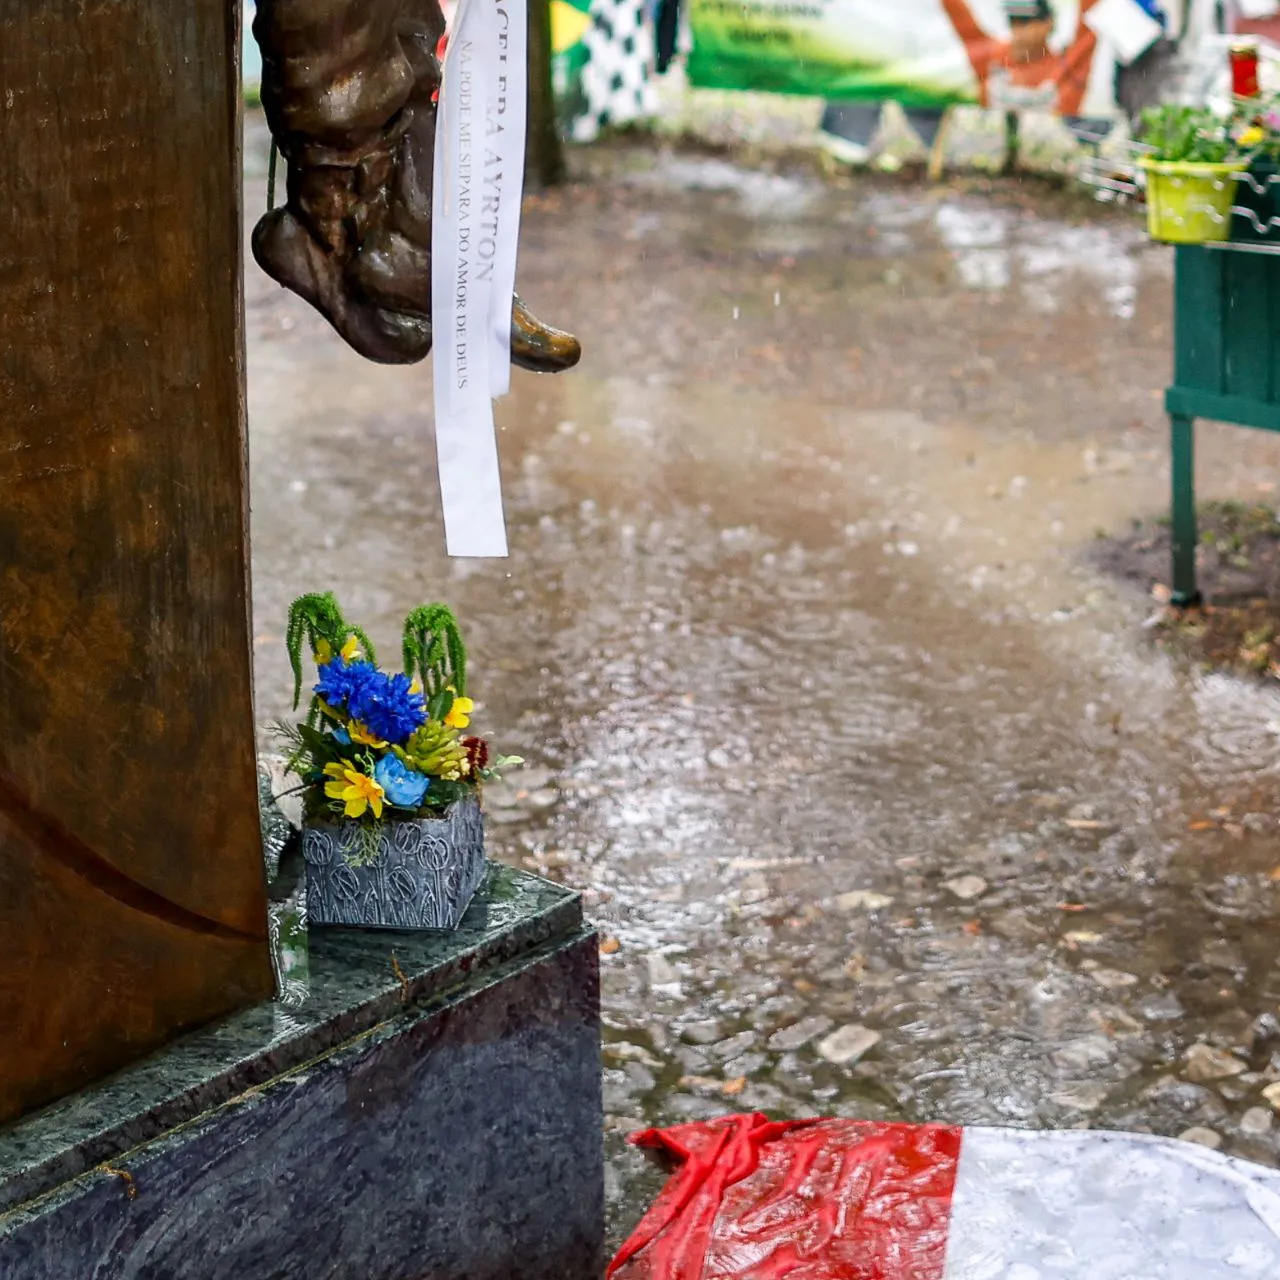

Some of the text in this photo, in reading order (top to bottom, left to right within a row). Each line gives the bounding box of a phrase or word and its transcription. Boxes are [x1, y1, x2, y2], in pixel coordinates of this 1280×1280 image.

[458, 71, 472, 117] PODE
[458, 122, 472, 148] ME
[458, 153, 472, 221] SEPARA
[474, 147, 504, 283] AYRTON
[457, 227, 471, 253] DO
[456, 257, 470, 310] AMOR
[455, 315, 468, 339] DE
[455, 343, 468, 389] DEUS
